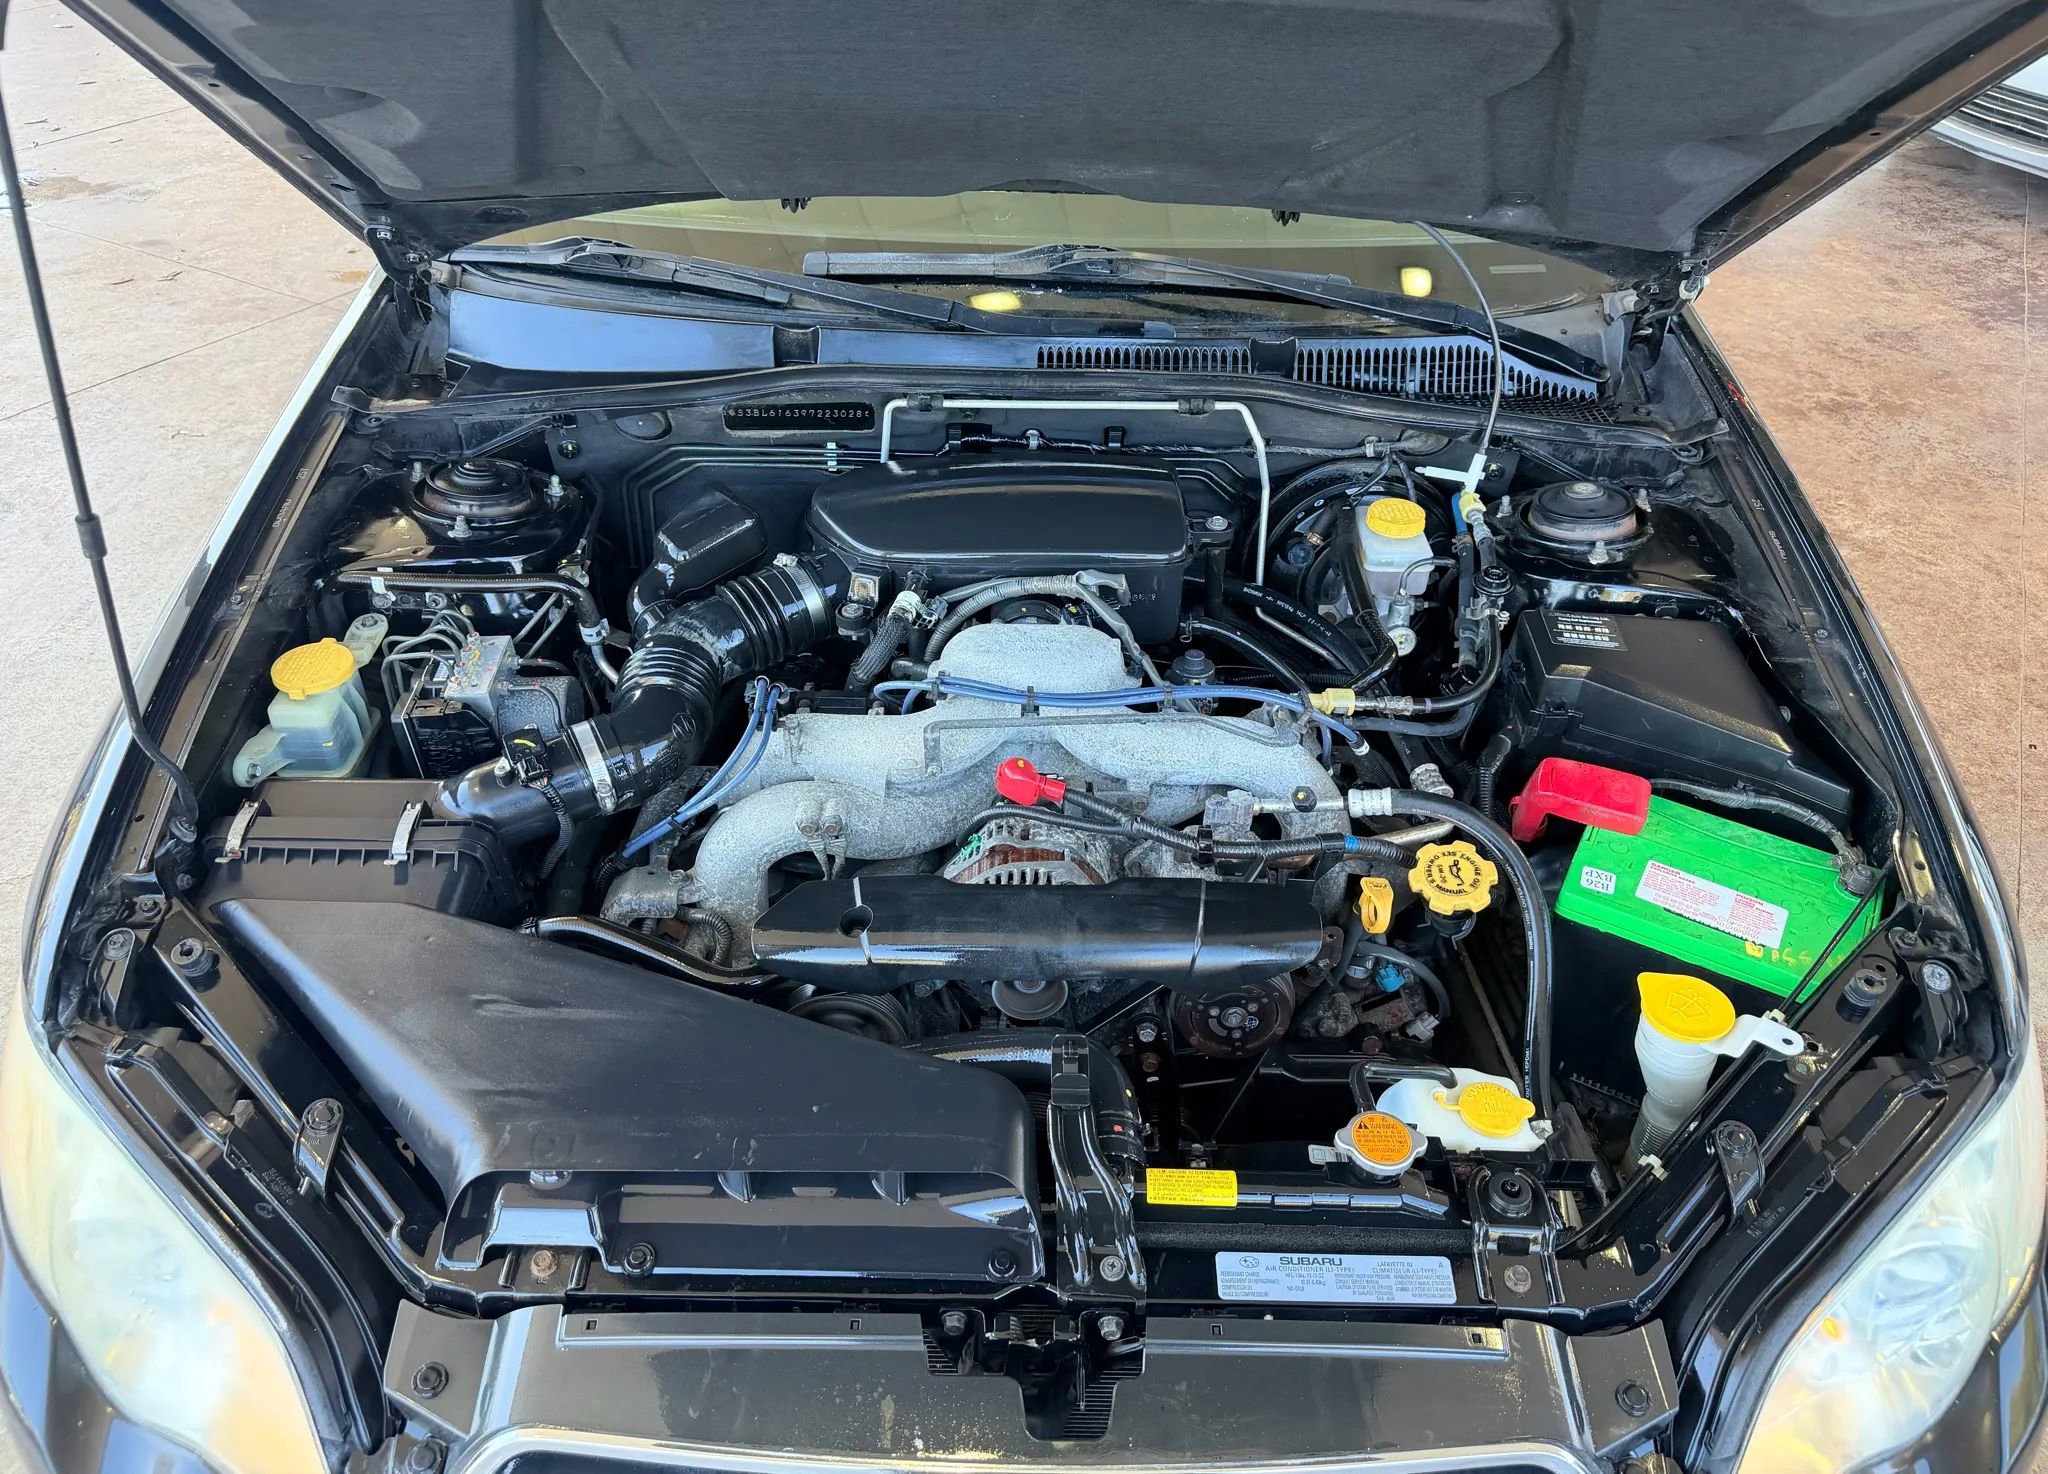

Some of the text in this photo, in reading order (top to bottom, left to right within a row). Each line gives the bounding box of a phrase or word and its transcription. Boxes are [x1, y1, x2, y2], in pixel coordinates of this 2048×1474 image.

[1768, 530, 1788, 561] SUBARU
[1460, 853, 1481, 888] ENGINE OIL
[1651, 863, 1681, 875] DANGER
[1585, 870, 1613, 883] BXP
[1435, 884, 1468, 895] MANUAL
[1586, 878, 1610, 891] B26
[1517, 887, 1527, 908] OUTER
[1736, 893, 1763, 906] POISON
[1279, 1256, 1343, 1266] SUBARU
